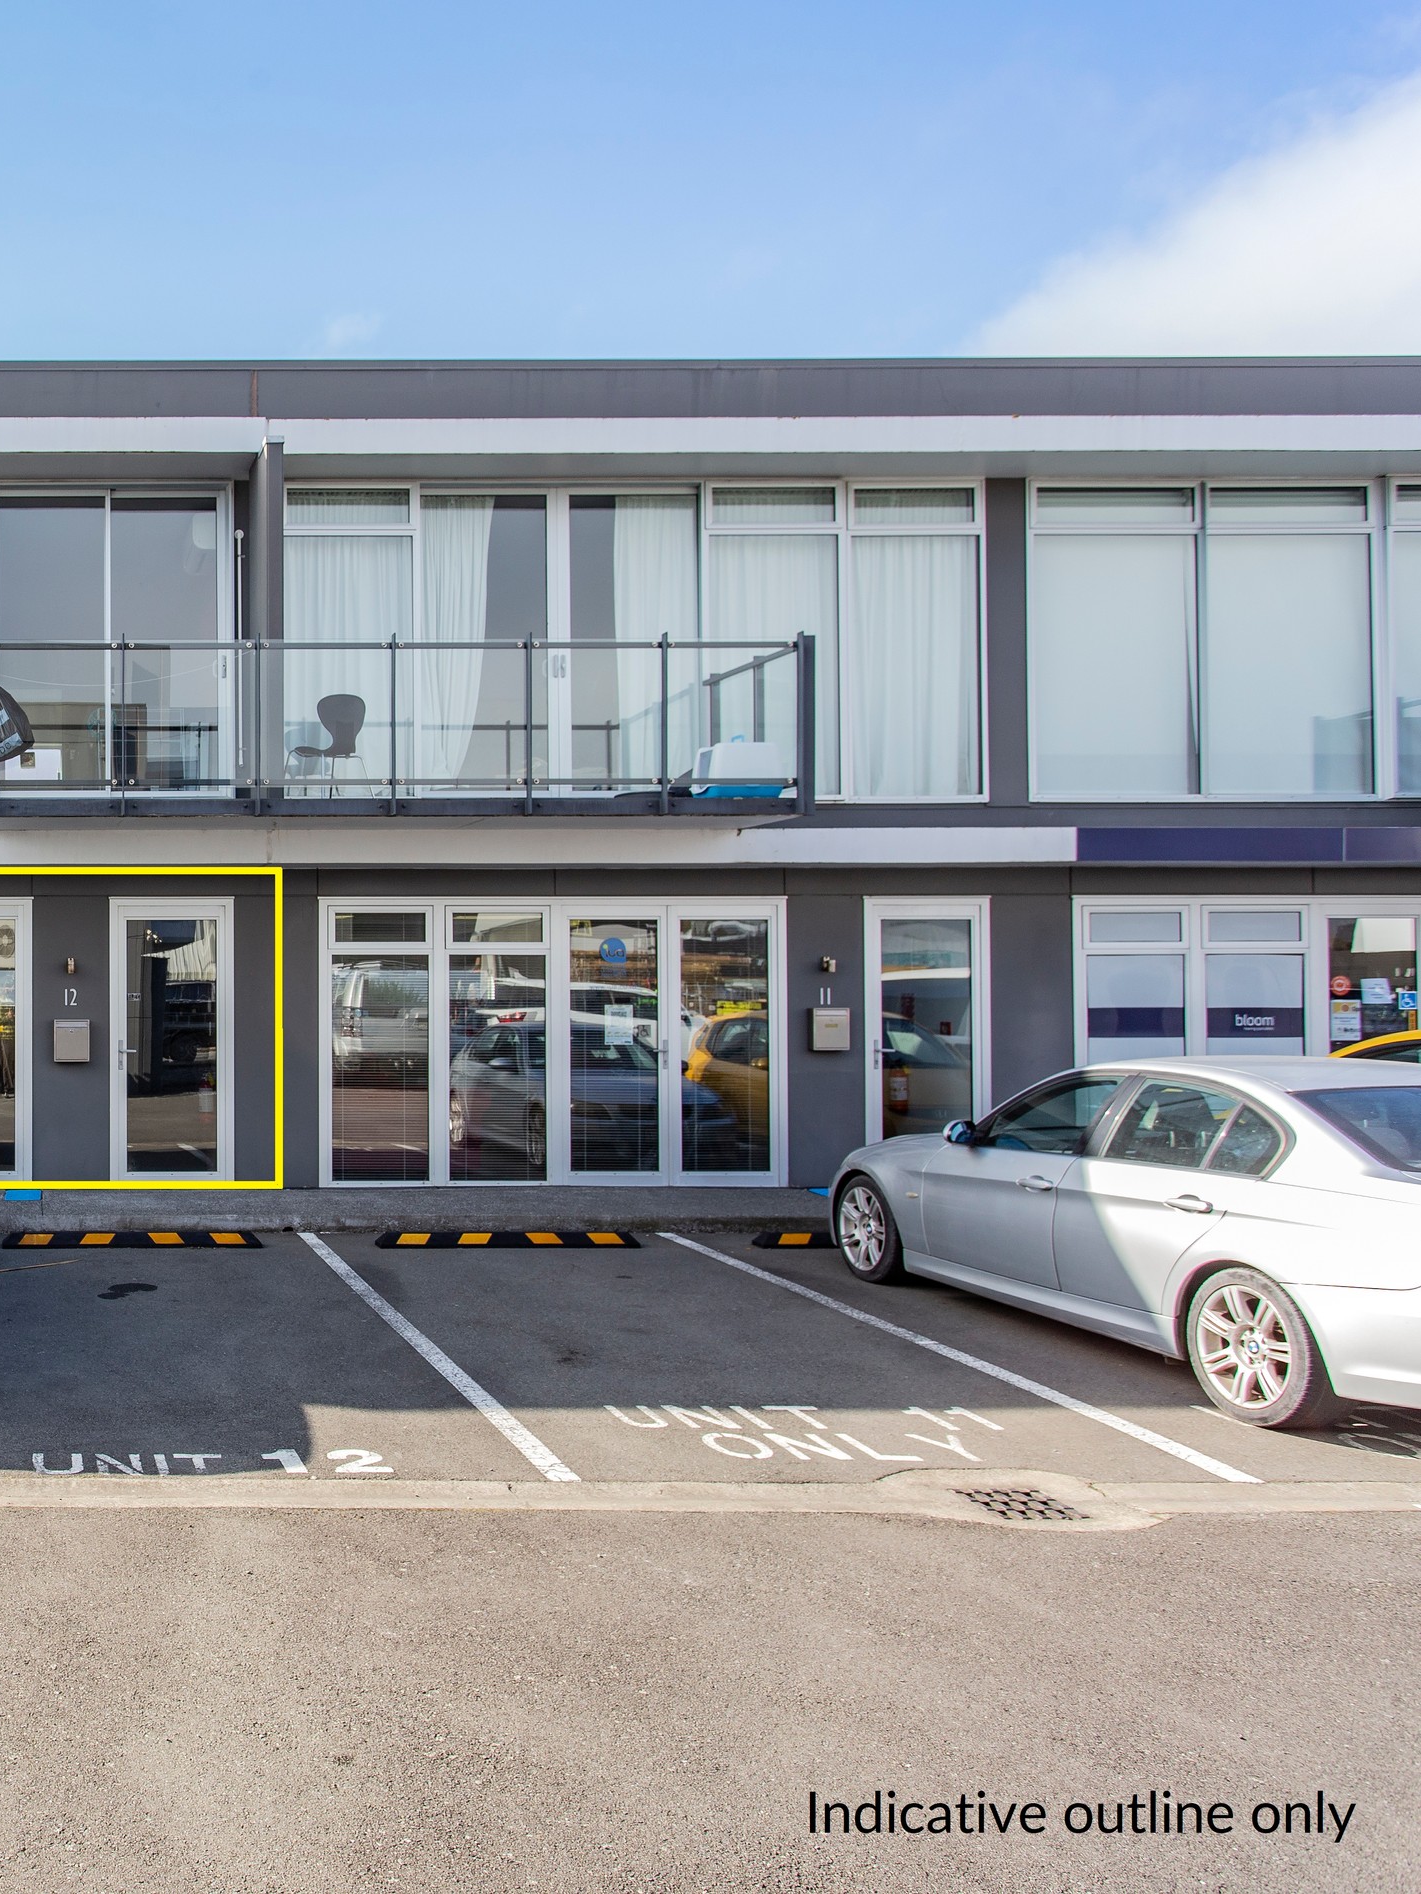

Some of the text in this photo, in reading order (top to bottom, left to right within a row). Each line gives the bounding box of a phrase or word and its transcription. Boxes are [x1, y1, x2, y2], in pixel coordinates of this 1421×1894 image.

[64, 988, 78, 1006] 12
[820, 987, 831, 1006] 11
[1235, 1014, 1276, 1026] bloom
[603, 1405, 1005, 1430] UNIT 11
[701, 1432, 983, 1461] ONLY
[31, 1448, 395, 1475] UNIT 12
